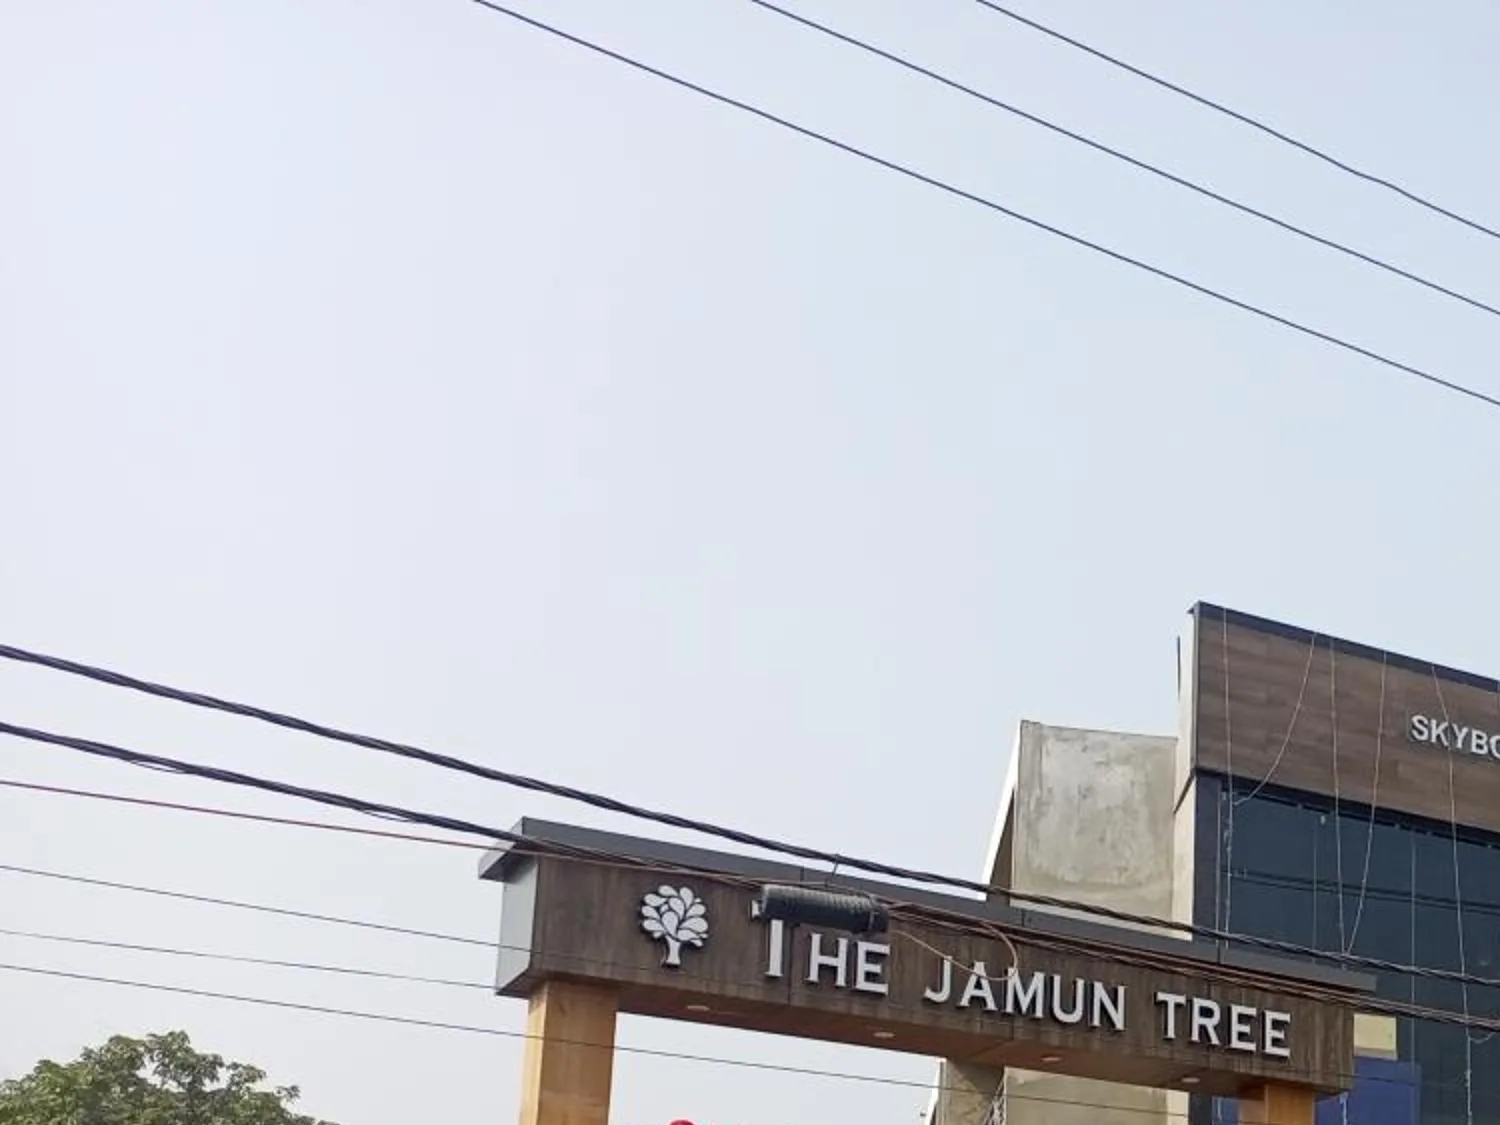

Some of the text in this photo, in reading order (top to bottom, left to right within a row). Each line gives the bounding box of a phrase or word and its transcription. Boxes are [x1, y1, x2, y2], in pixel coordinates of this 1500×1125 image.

[751, 899, 1291, 1057] THE JAMUN TREE
